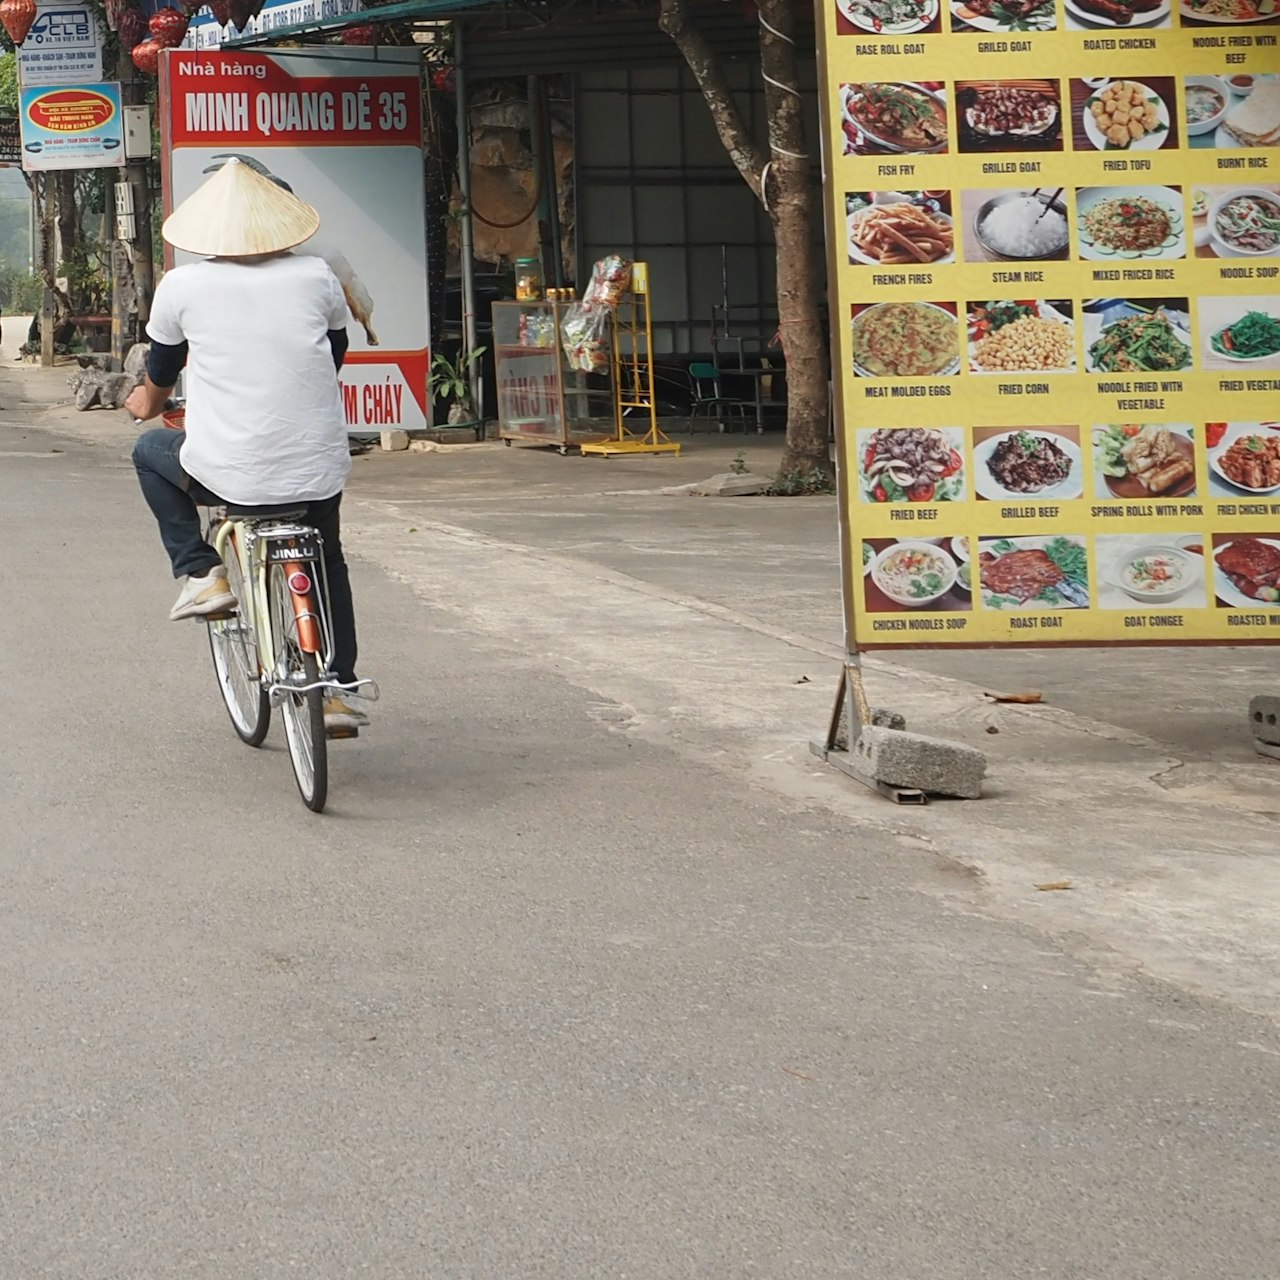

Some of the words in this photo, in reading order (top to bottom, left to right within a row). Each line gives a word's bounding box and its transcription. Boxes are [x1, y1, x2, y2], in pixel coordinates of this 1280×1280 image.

[50, 24, 89, 35] CLB
[978, 41, 1008, 53] GRILED
[1010, 41, 1032, 52] GOAT
[1084, 39, 1116, 50] ROATED
[1118, 38, 1156, 49] CHICKEN
[1193, 37, 1226, 48] NOODLE
[1228, 36, 1252, 47] FRIED
[1255, 35, 1277, 46] WITH
[856, 44, 879, 56] RASE
[881, 44, 902, 55] ROLL
[904, 43, 925, 54] GOAT
[1226, 53, 1246, 64] BEEF
[179, 61, 215, 76] Nhà
[220, 61, 266, 78] hàng
[185, 92, 249, 132] MINH
[256, 91, 334, 136] QUANG
[342, 83, 372, 130] DÊ
[379, 91, 407, 130] 35
[982, 163, 1017, 174] GRILLED
[1020, 162, 1041, 173] GOAT
[1104, 160, 1128, 171] FRIED
[1130, 159, 1151, 170] TOFU
[1218, 158, 1246, 169] BURNT
[1248, 157, 1268, 168] RICE
[878, 165, 897, 176] FISH
[900, 164, 915, 175] FRY
[992, 272, 1021, 283] STEAM
[1024, 271, 1044, 282] RICE
[1093, 270, 1120, 281] MIXED
[1123, 269, 1153, 280] FRICED
[1155, 268, 1175, 280] RICE
[1220, 268, 1253, 278] NOODLE
[1256, 266, 1279, 277] SOUP
[873, 274, 906, 285] FRENCH
[908, 274, 932, 285] FIRES
[865, 386, 888, 397] MEAT
[891, 386, 926, 397] MOLDED
[928, 385, 951, 396] EGGS
[999, 384, 1023, 395] FRIED
[1025, 383, 1049, 394] CORN
[1098, 382, 1131, 393] NOODLE
[1134, 381, 1158, 392] FRIED
[1161, 381, 1183, 392] WITH
[1219, 380, 1244, 391] FRIED
[340, 381, 358, 425] M
[363, 375, 402, 425] CHÁY
[1117, 398, 1165, 410] VEGETABLE
[890, 509, 915, 520] FRIED
[917, 509, 938, 520] BEEF
[1001, 507, 1036, 518] GRILLED
[1039, 507, 1060, 518] BEEF
[1091, 506, 1124, 517] SPRING
[1126, 506, 1153, 517] ROLLS
[1156, 505, 1178, 516] WITH
[1180, 505, 1204, 516] PORK
[1217, 504, 1236, 515] FRIED
[1239, 504, 1268, 515] CHICKEN
[271, 547, 314, 559] JINLU
[873, 619, 907, 631] CHICKEN
[909, 619, 944, 630] NOODLES
[947, 618, 966, 629] SOUP
[1010, 618, 1038, 629] ROAST
[1041, 617, 1063, 628] GOAT
[1124, 616, 1147, 627] GOAT
[1149, 616, 1184, 626] CONGEE
[1227, 615, 1266, 626] ROASTED
